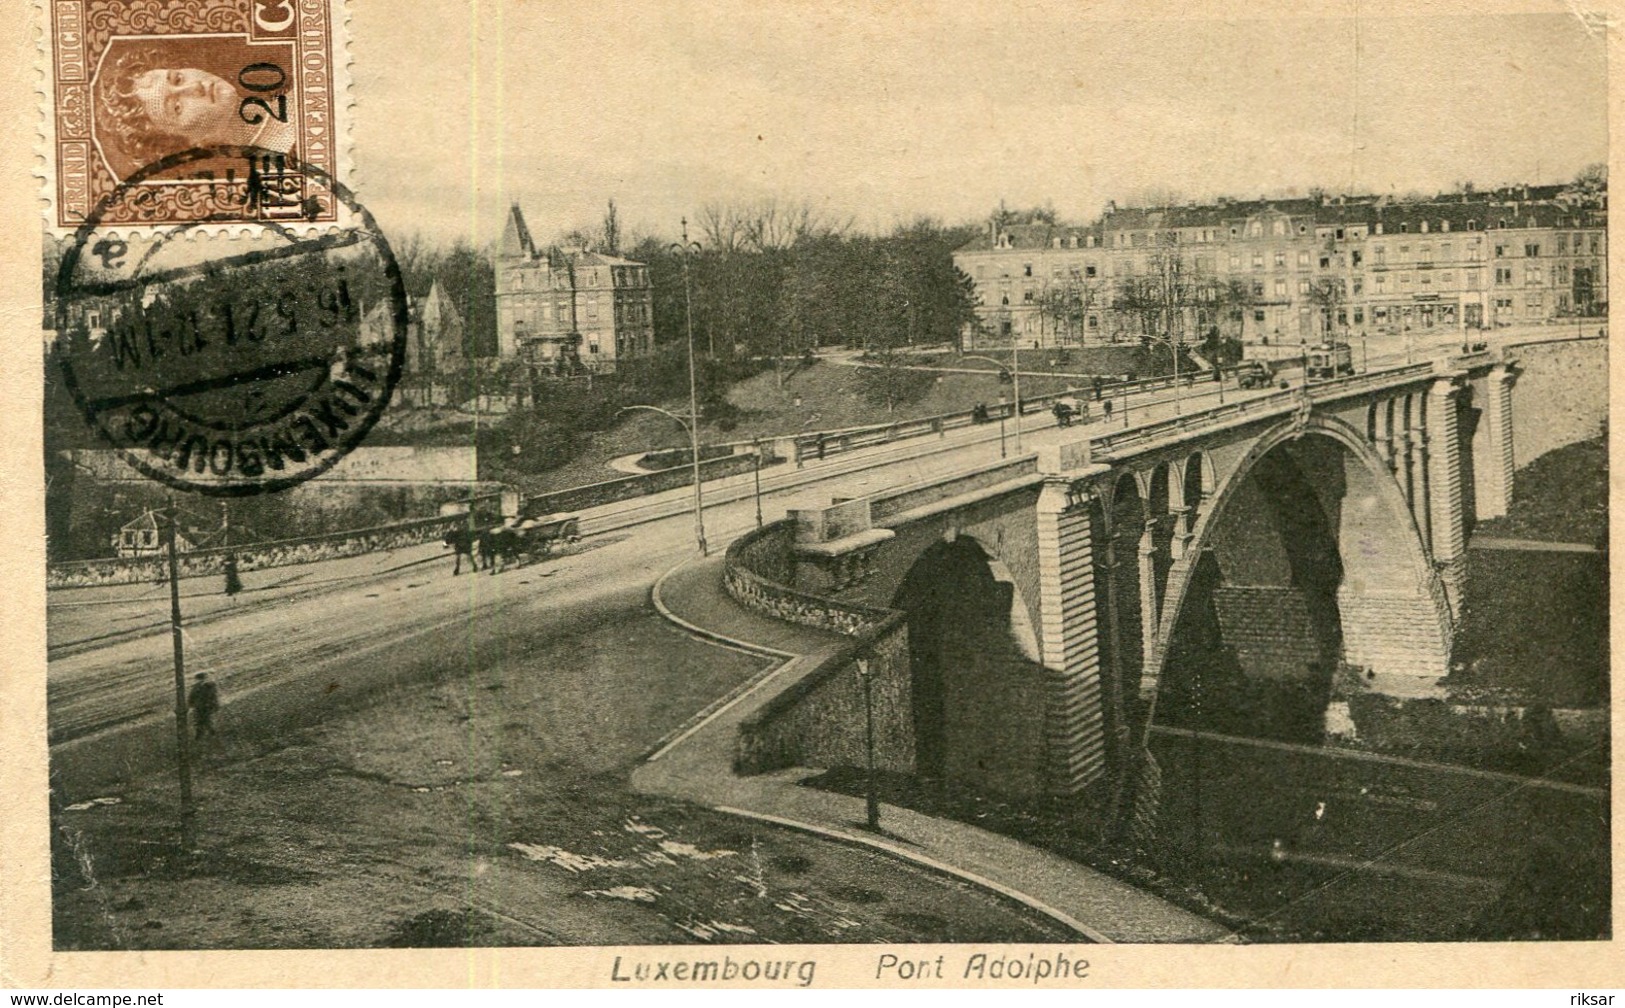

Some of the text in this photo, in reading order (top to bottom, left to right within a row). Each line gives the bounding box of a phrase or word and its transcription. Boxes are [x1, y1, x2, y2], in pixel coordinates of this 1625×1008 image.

[238, 62, 288, 125] 20
[301, 0, 330, 178] UXEMBOURG
[63, 143, 89, 220] GRAND
[611, 952, 1091, 987] Luxembourg Pont Adolphe
